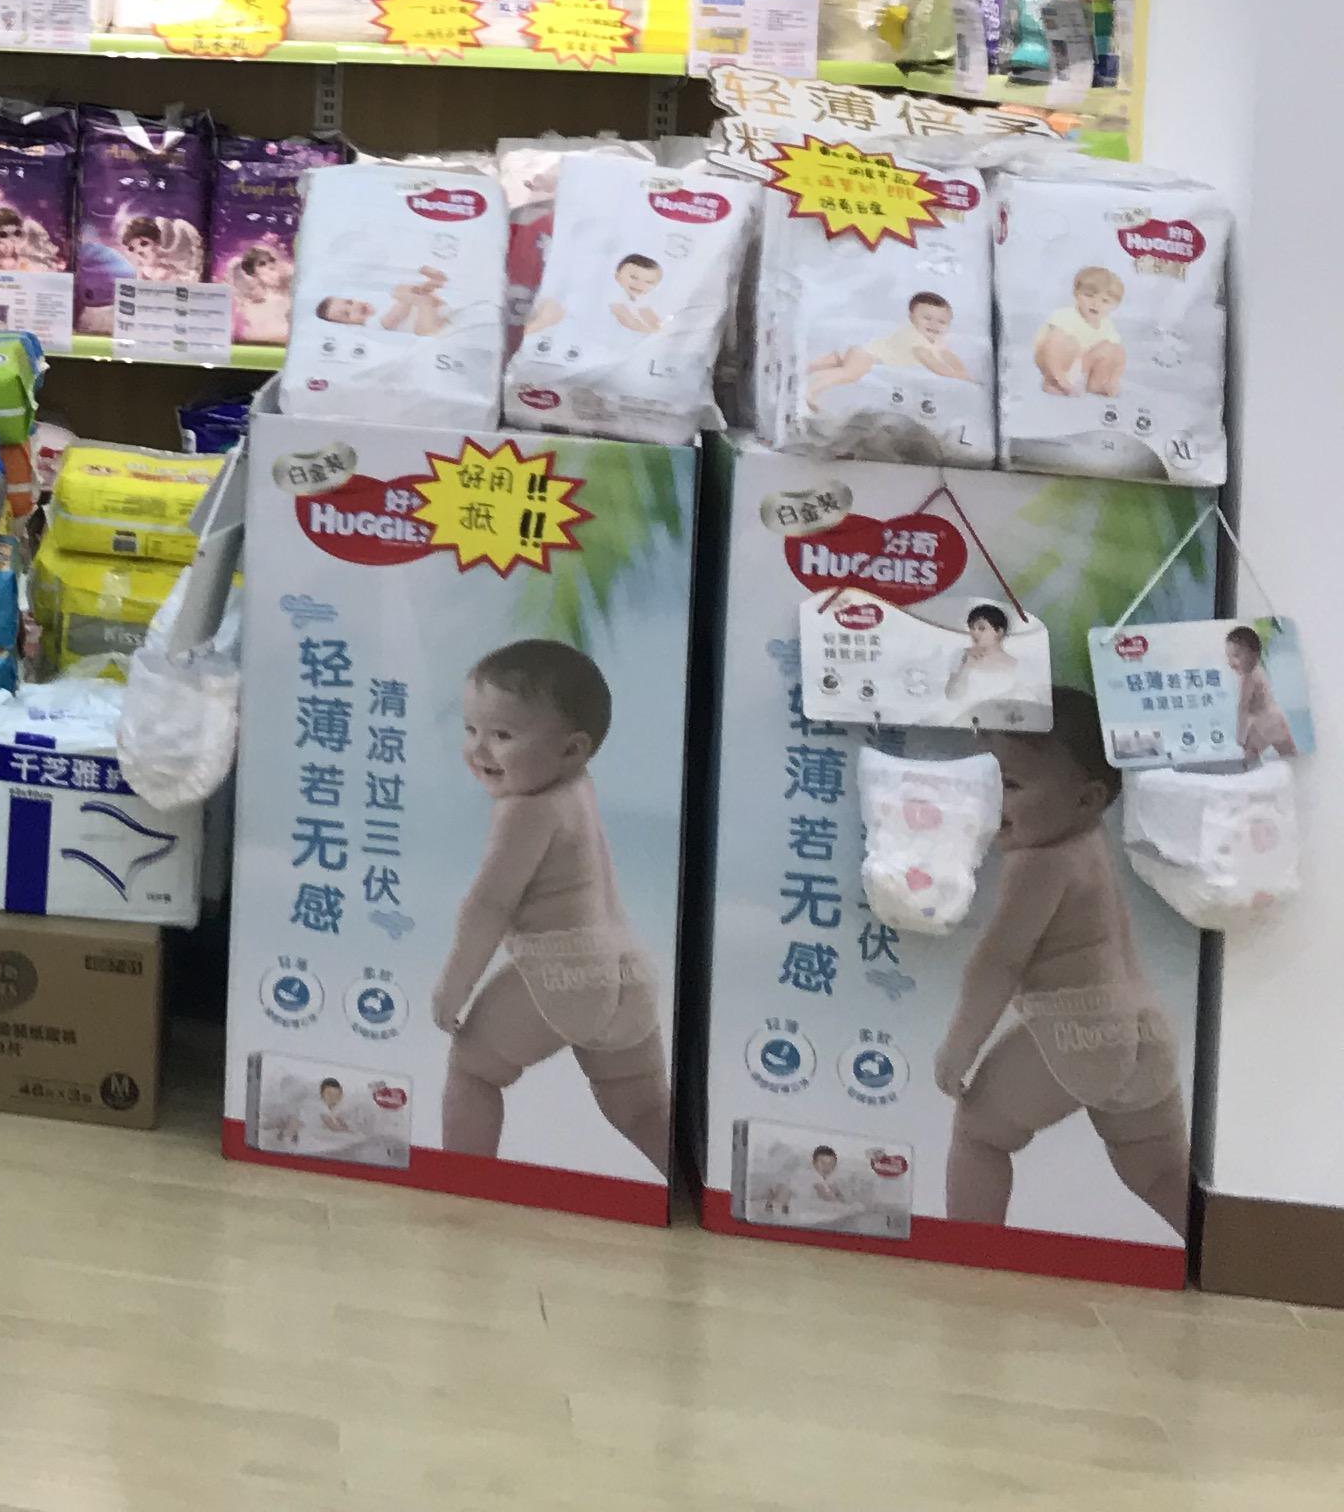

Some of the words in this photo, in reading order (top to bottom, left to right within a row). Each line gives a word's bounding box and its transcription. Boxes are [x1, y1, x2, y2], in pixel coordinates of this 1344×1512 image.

[799, 542, 938, 586] HUGGIES
[882, 528, 938, 558] 好奇
[287, 637, 354, 934] 轻薄若无感
[362, 678, 408, 906] 清凉过三伏
